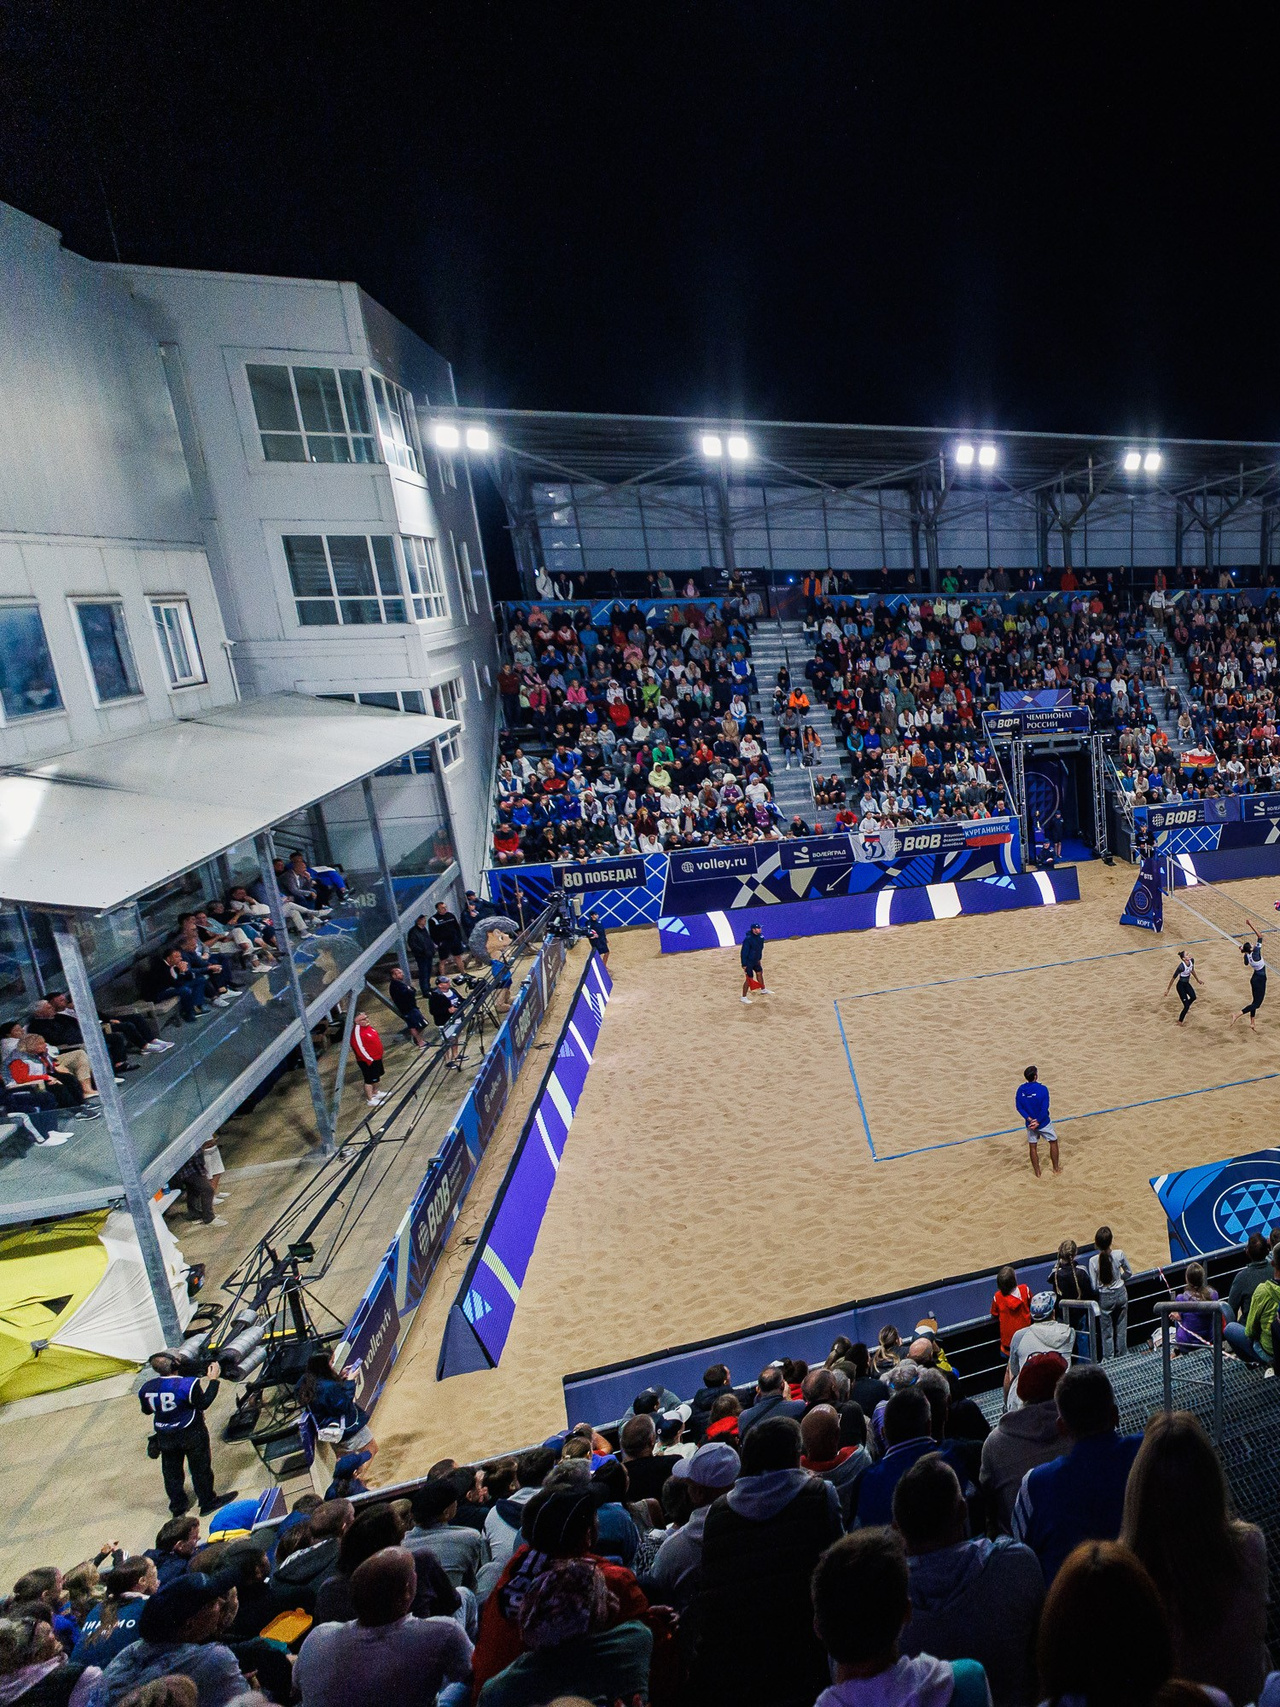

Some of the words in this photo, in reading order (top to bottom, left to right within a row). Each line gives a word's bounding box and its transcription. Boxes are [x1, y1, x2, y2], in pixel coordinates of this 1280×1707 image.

[1026, 711, 1072, 720] ЧЕМПИОНАТ
[1026, 721, 1058, 729] РОССИИ
[1165, 809, 1197, 826] ВФВ
[964, 824, 1010, 837] КУРГАНИНСК
[903, 834, 942, 852] ВФВ
[812, 849, 847, 858] ВОЛЕЙГРАД
[696, 857, 747, 871] volley.ru
[564, 872, 583, 888] 80
[585, 867, 637, 884] ПОБЕДА!
[1137, 919, 1150, 927] КОРТ
[427, 1173, 451, 1243] ВФВ
